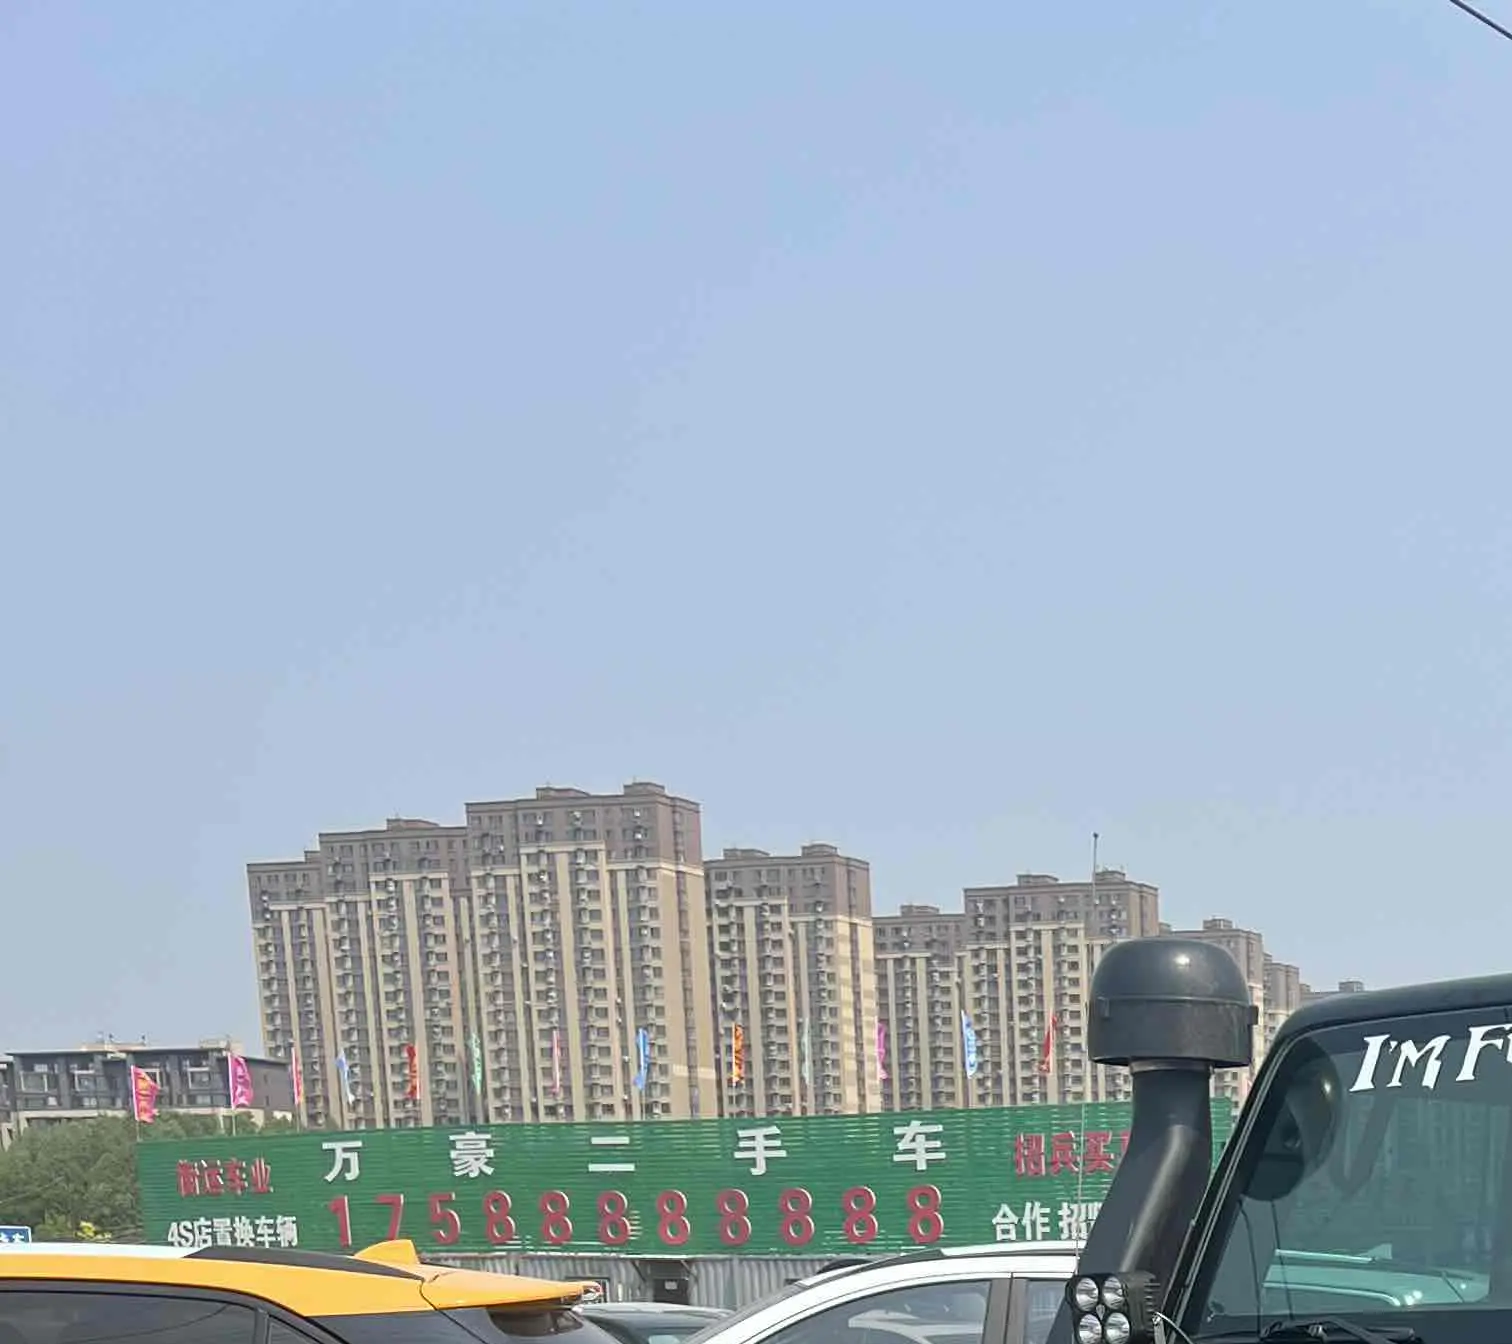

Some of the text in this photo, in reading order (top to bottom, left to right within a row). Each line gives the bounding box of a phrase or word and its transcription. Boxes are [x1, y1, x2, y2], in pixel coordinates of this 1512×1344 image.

[1349, 1033, 1446, 1094] I'M
[321, 1120, 947, 1182] 万豪二手车
[1014, 1130, 1130, 1178] 招兵买
[167, 1215, 299, 1248] 4S店置换车辆
